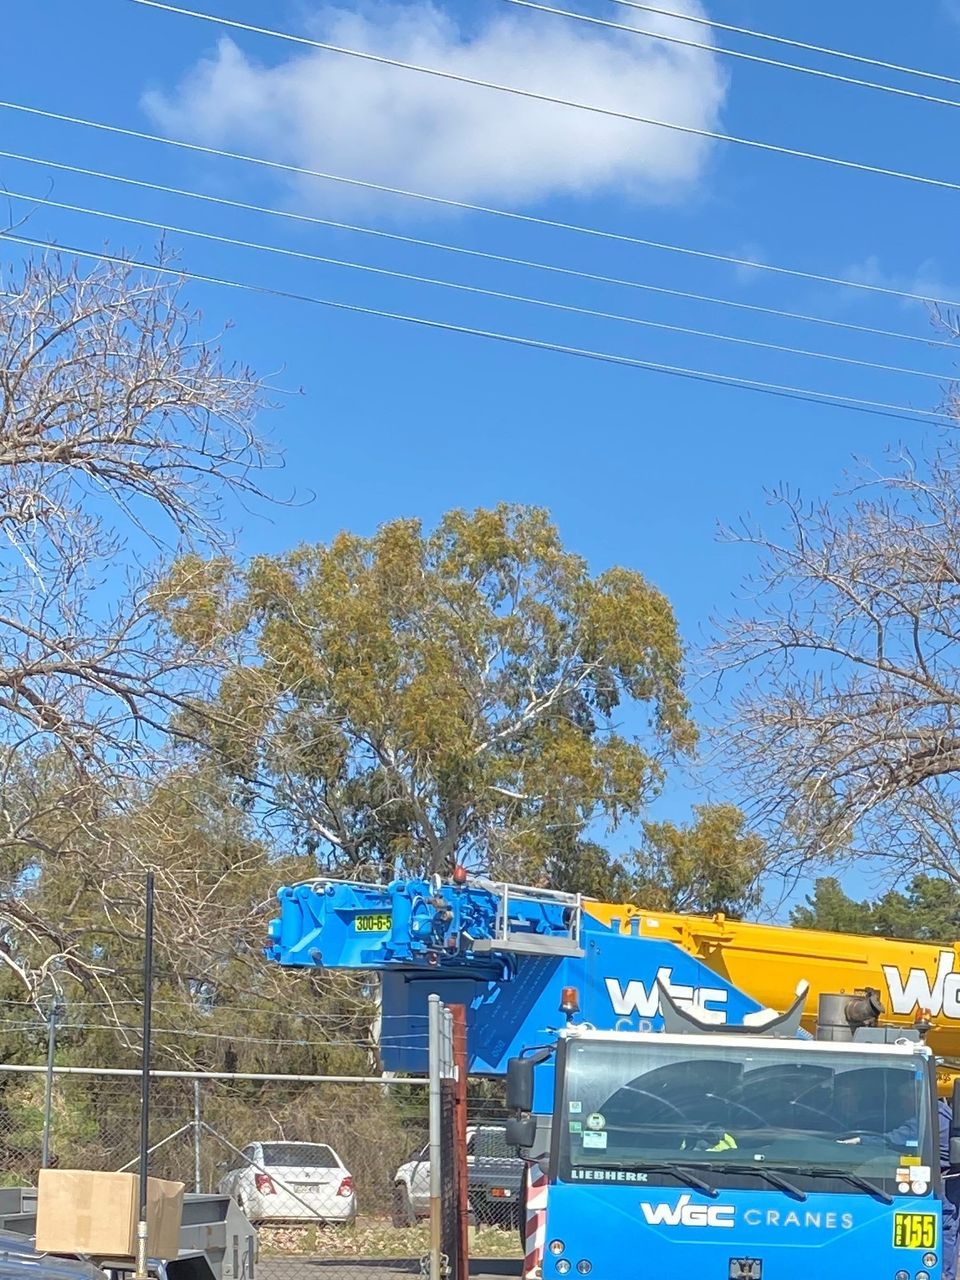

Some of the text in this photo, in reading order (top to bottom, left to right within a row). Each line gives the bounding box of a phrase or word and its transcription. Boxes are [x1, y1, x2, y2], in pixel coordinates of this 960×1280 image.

[571, 1170, 648, 1181] LIEBHERR
[640, 1194, 853, 1229] WGC CRANES
[903, 1214, 934, 1248] 155
